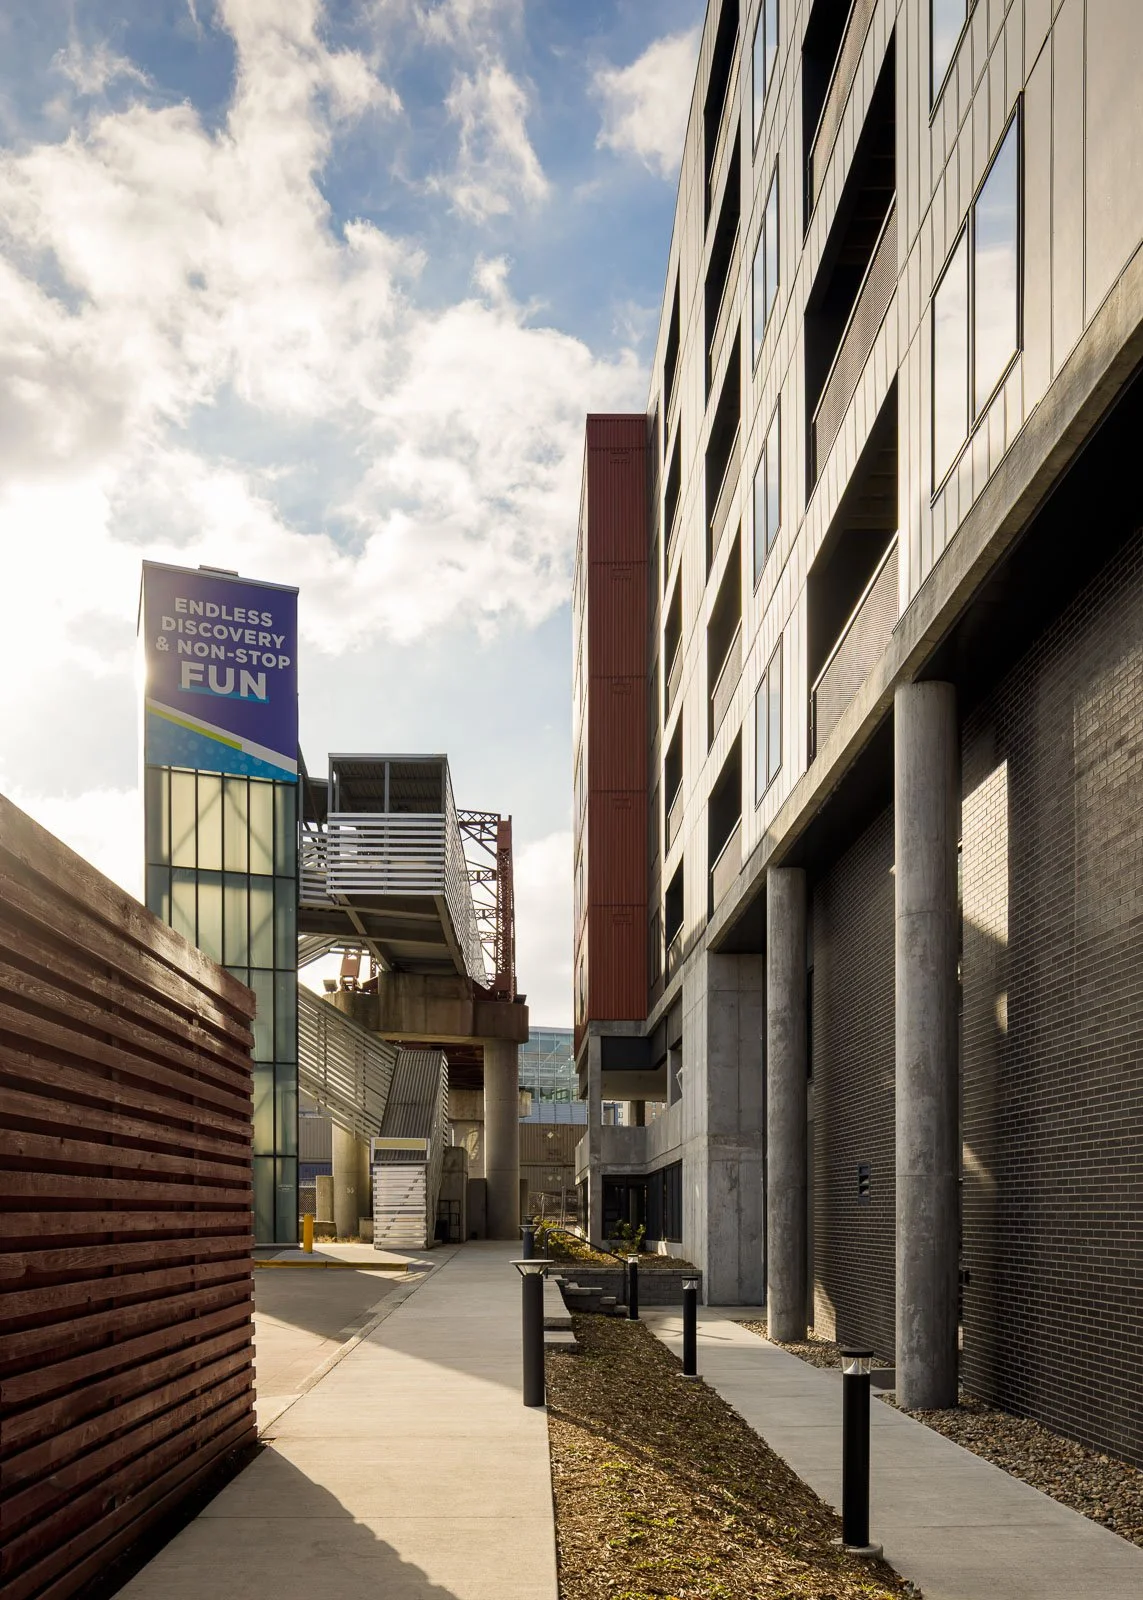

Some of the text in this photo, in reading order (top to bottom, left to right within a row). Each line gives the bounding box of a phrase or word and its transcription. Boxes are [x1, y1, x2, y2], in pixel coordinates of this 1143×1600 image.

[175, 597, 273, 627] ENDLESS
[161, 615, 286, 649] DISCOVERY
[155, 636, 291, 669] & NON-STOP
[181, 660, 266, 700] FUN
